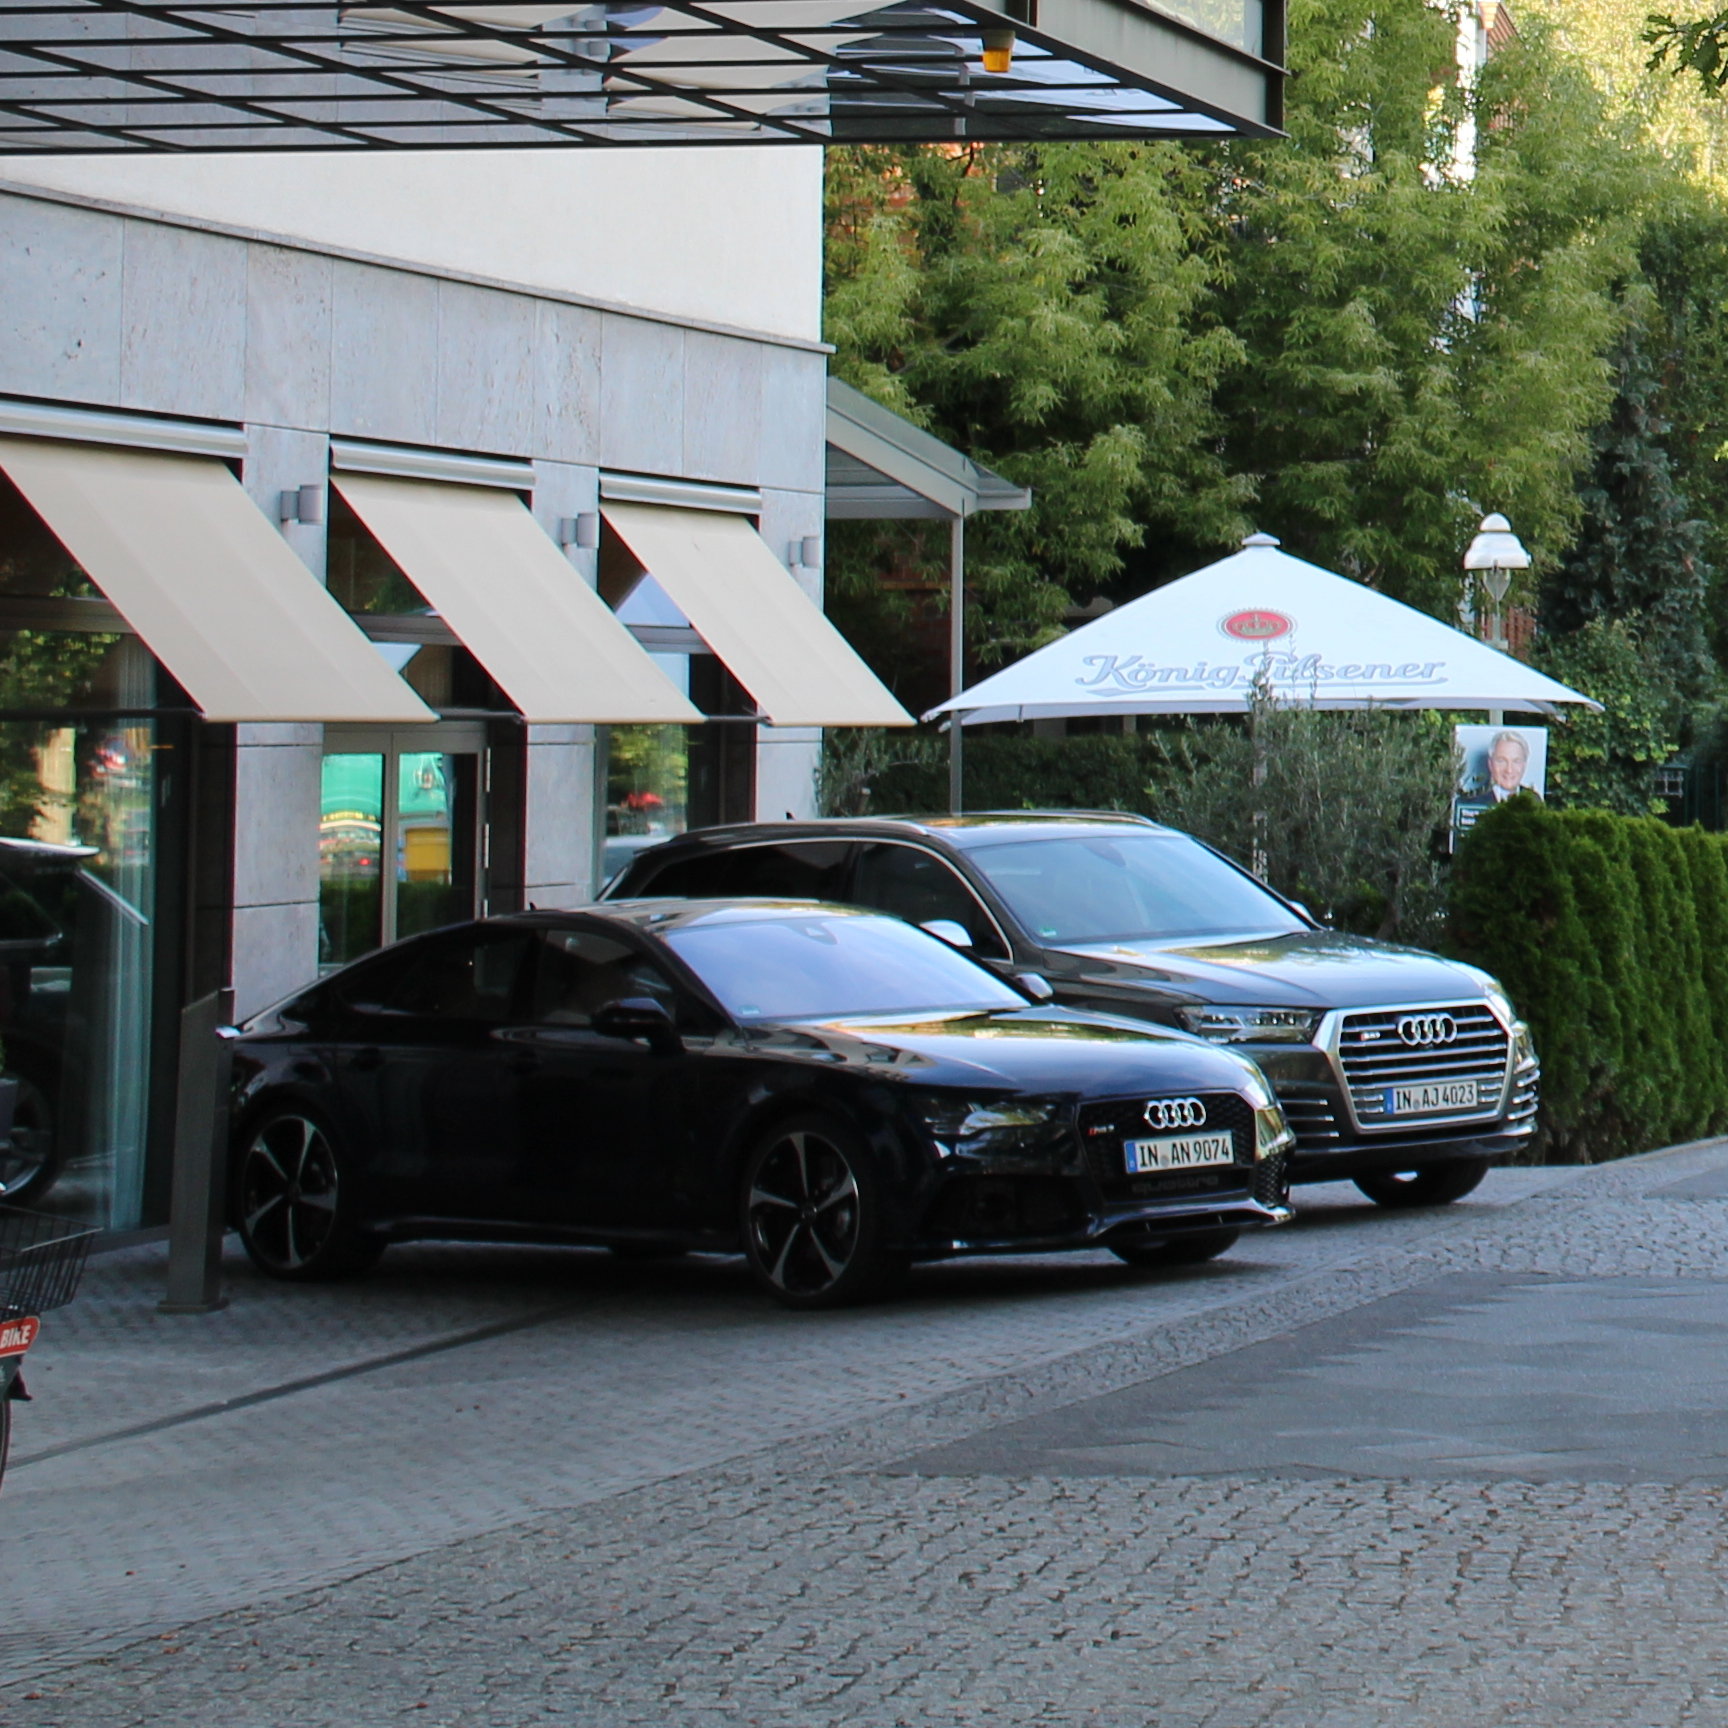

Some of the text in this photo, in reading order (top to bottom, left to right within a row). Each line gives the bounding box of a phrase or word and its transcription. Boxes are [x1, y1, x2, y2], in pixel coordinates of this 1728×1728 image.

[1075, 655, 1239, 689] König
[1396, 1083, 1474, 1110] IN AJ 4023
[1139, 1138, 1230, 1168] IN AN 9074
[0, 1324, 32, 1350] BIKE
